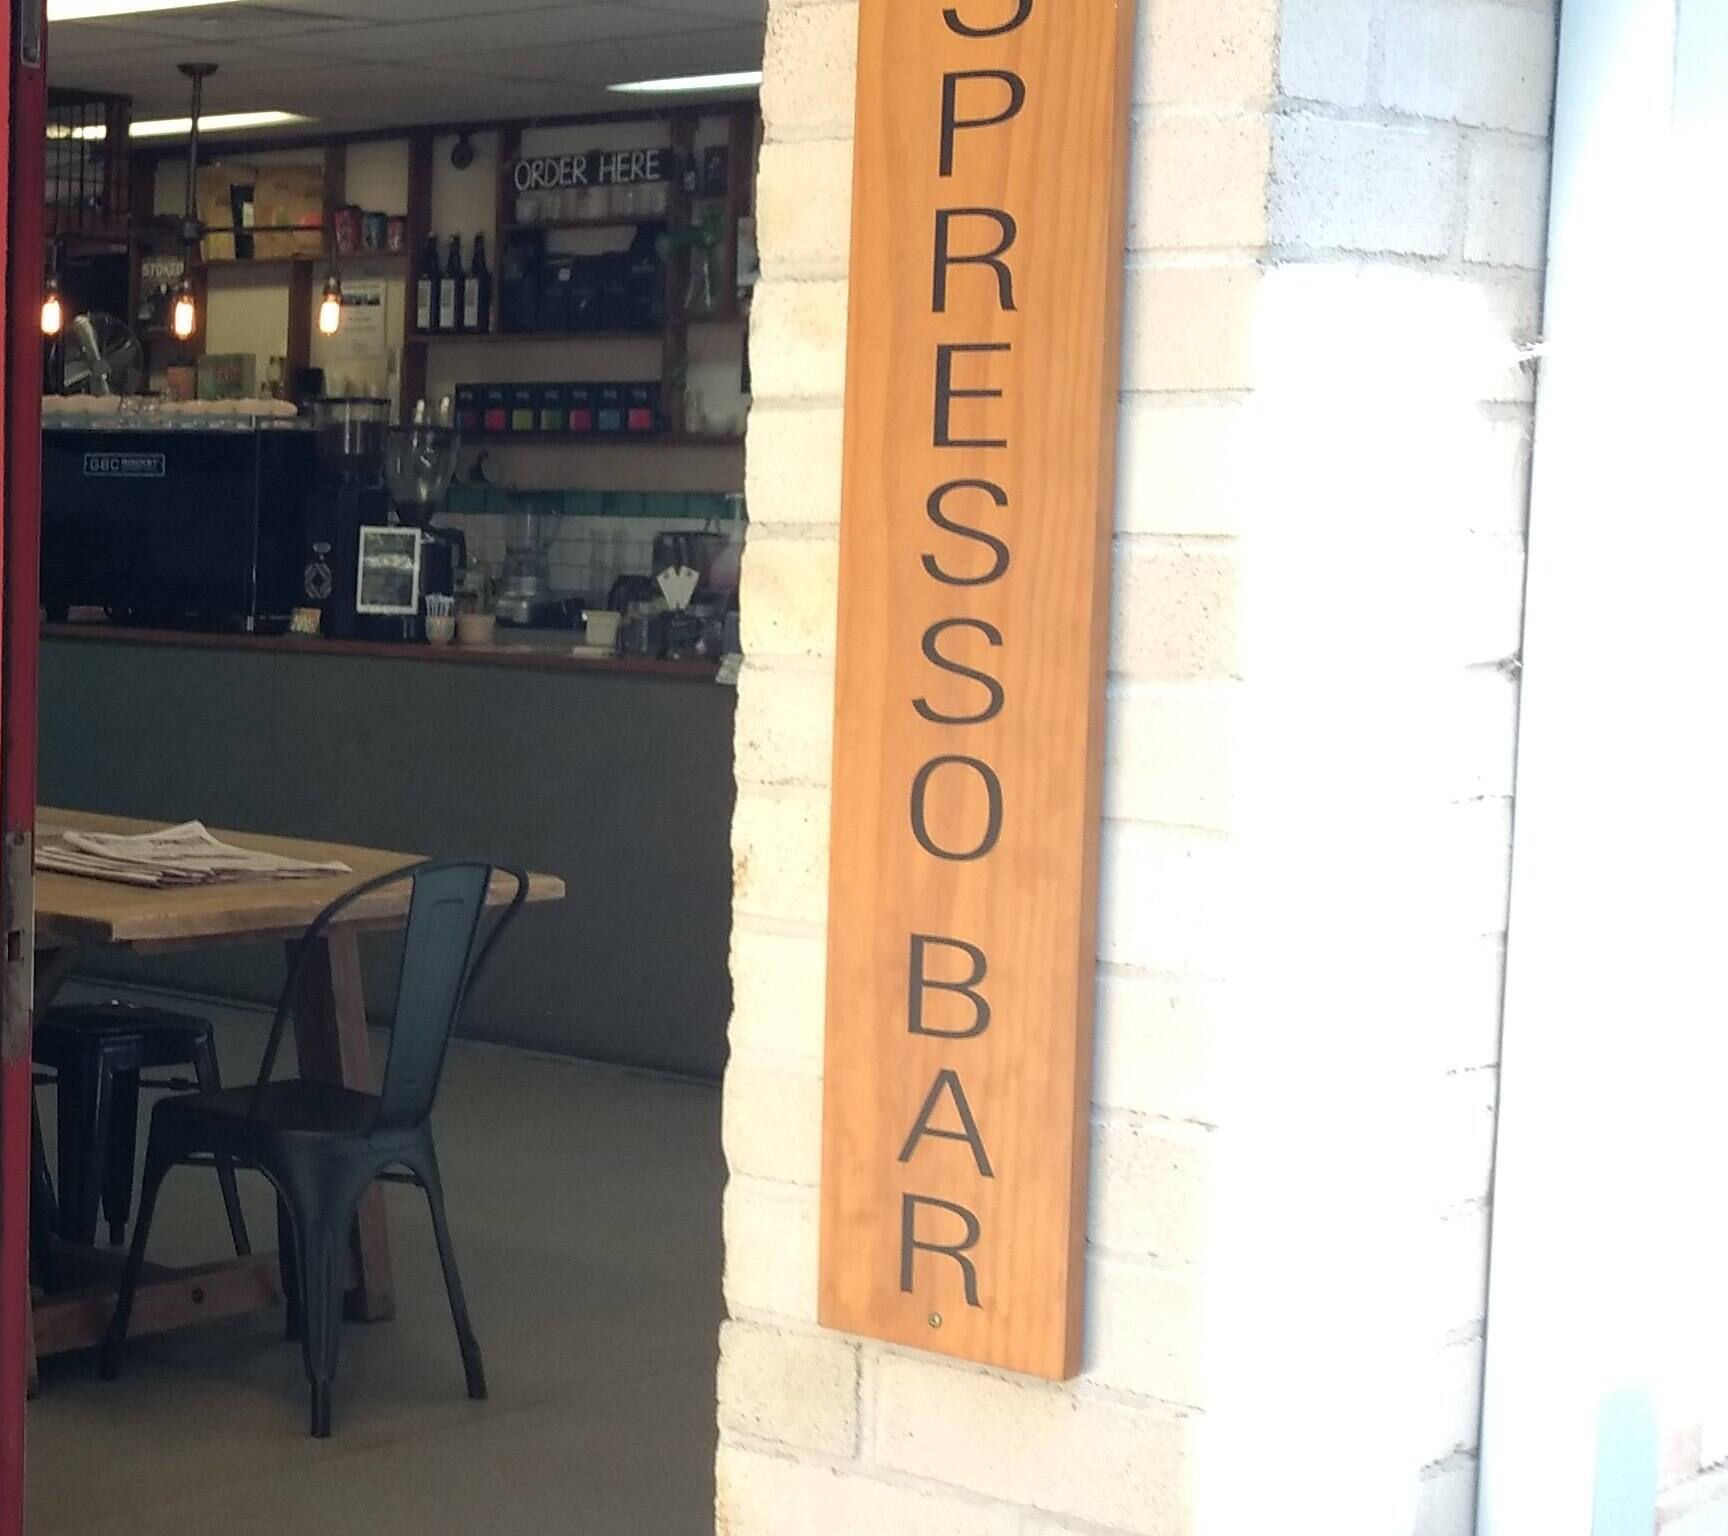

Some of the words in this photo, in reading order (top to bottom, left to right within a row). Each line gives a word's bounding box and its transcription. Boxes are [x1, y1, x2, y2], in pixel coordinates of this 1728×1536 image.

[514, 155, 588, 191] ORDER
[598, 149, 661, 184] HERE
[896, 932, 992, 1309] BAR
